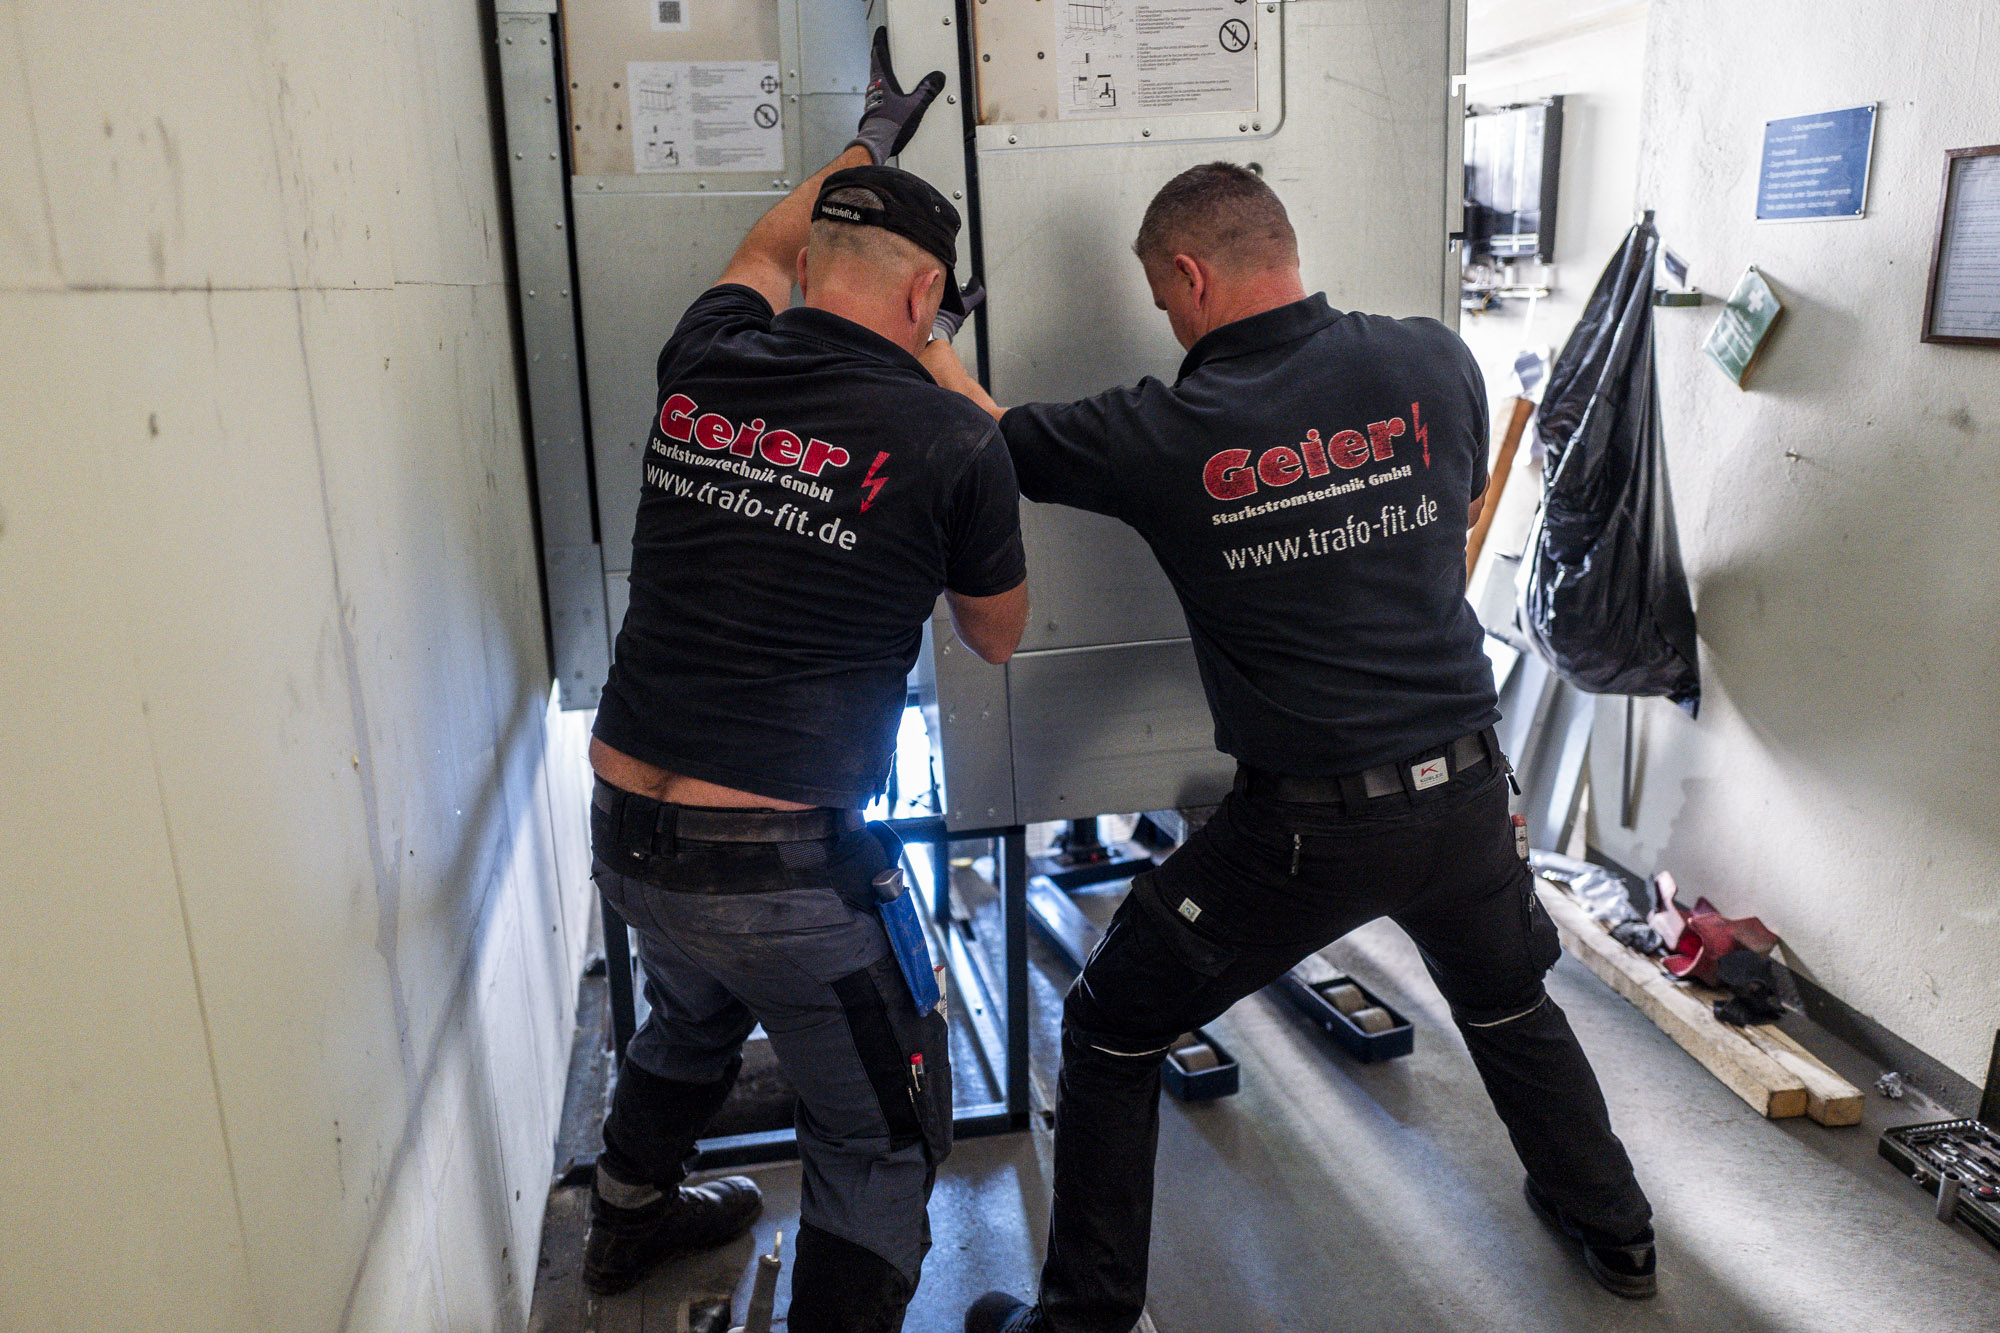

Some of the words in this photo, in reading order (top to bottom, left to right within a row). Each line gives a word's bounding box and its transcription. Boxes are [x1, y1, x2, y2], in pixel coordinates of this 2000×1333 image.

[651, 437, 778, 484] Starkstromtechnik
[780, 474, 834, 503] GmbH
[660, 393, 850, 477] Geier
[1202, 417, 1406, 501] Geier
[646, 463, 857, 551] www.trafo-fit.de
[1212, 477, 1366, 526] Starkstromtechnik
[1368, 464, 1412, 487] GmbH
[1222, 494, 1438, 571] www.trafo-fit.de
